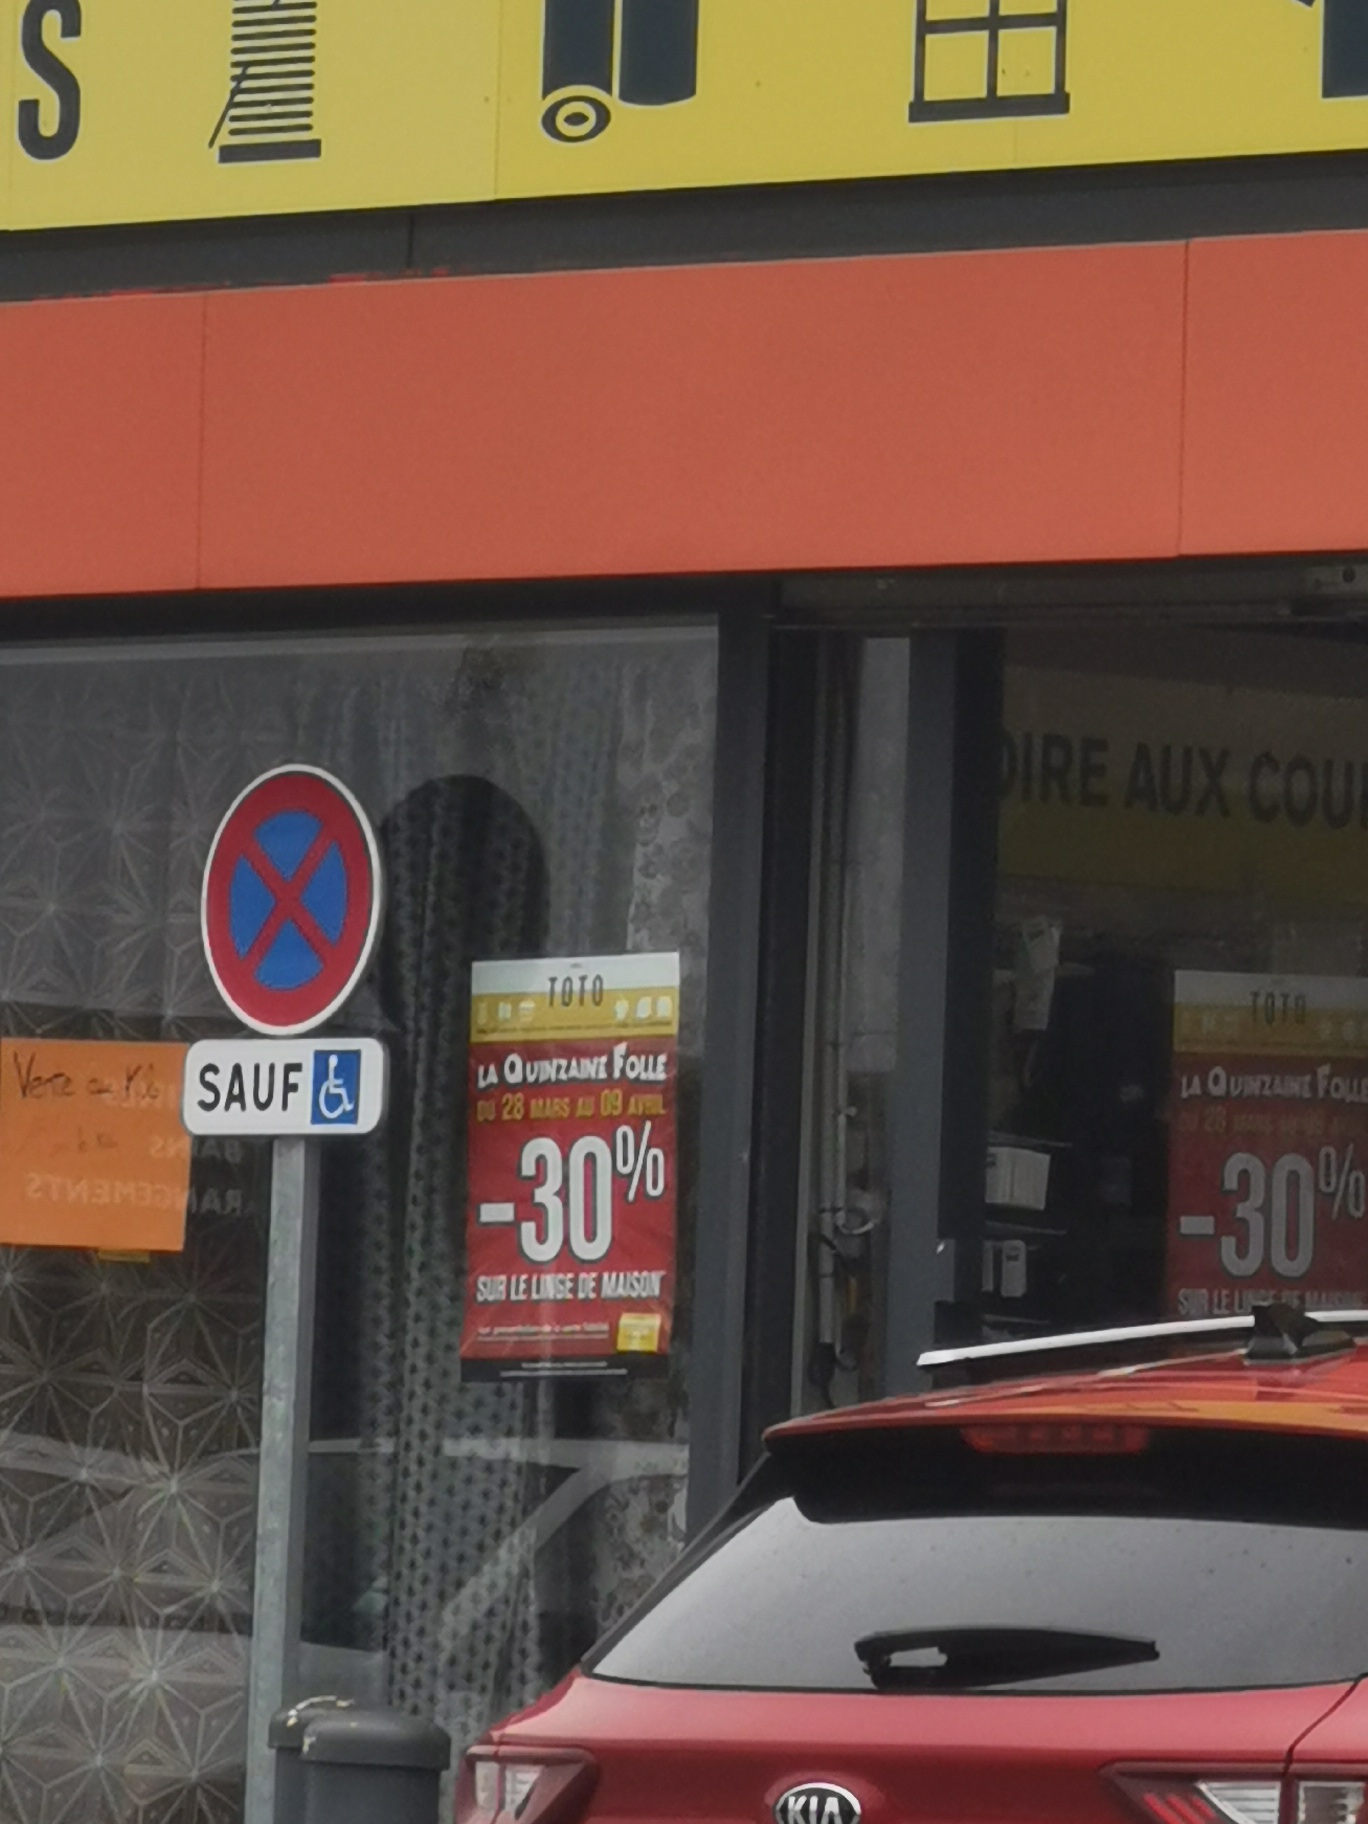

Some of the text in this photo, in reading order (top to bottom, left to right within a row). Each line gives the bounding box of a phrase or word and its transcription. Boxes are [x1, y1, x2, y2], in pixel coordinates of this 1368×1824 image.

[1123, 740, 1231, 819] AUX
[547, 973, 605, 1008] TOTO
[1249, 991, 1307, 1026] TOTO
[477, 1040, 668, 1089] LA QUINZAINE FOLLE
[197, 1061, 304, 1114] SAUF
[1180, 1074, 1202, 1100] LA
[1207, 1065, 1313, 1097] QUINZAINE
[501, 1091, 525, 1121] 28
[599, 1088, 624, 1117] 09
[475, 1273, 508, 1303] SUR
[510, 1272, 529, 1302] LE
[577, 1270, 599, 1300] DE
[600, 1269, 667, 1299] MAISON
[787, 1794, 843, 1824] KIA
